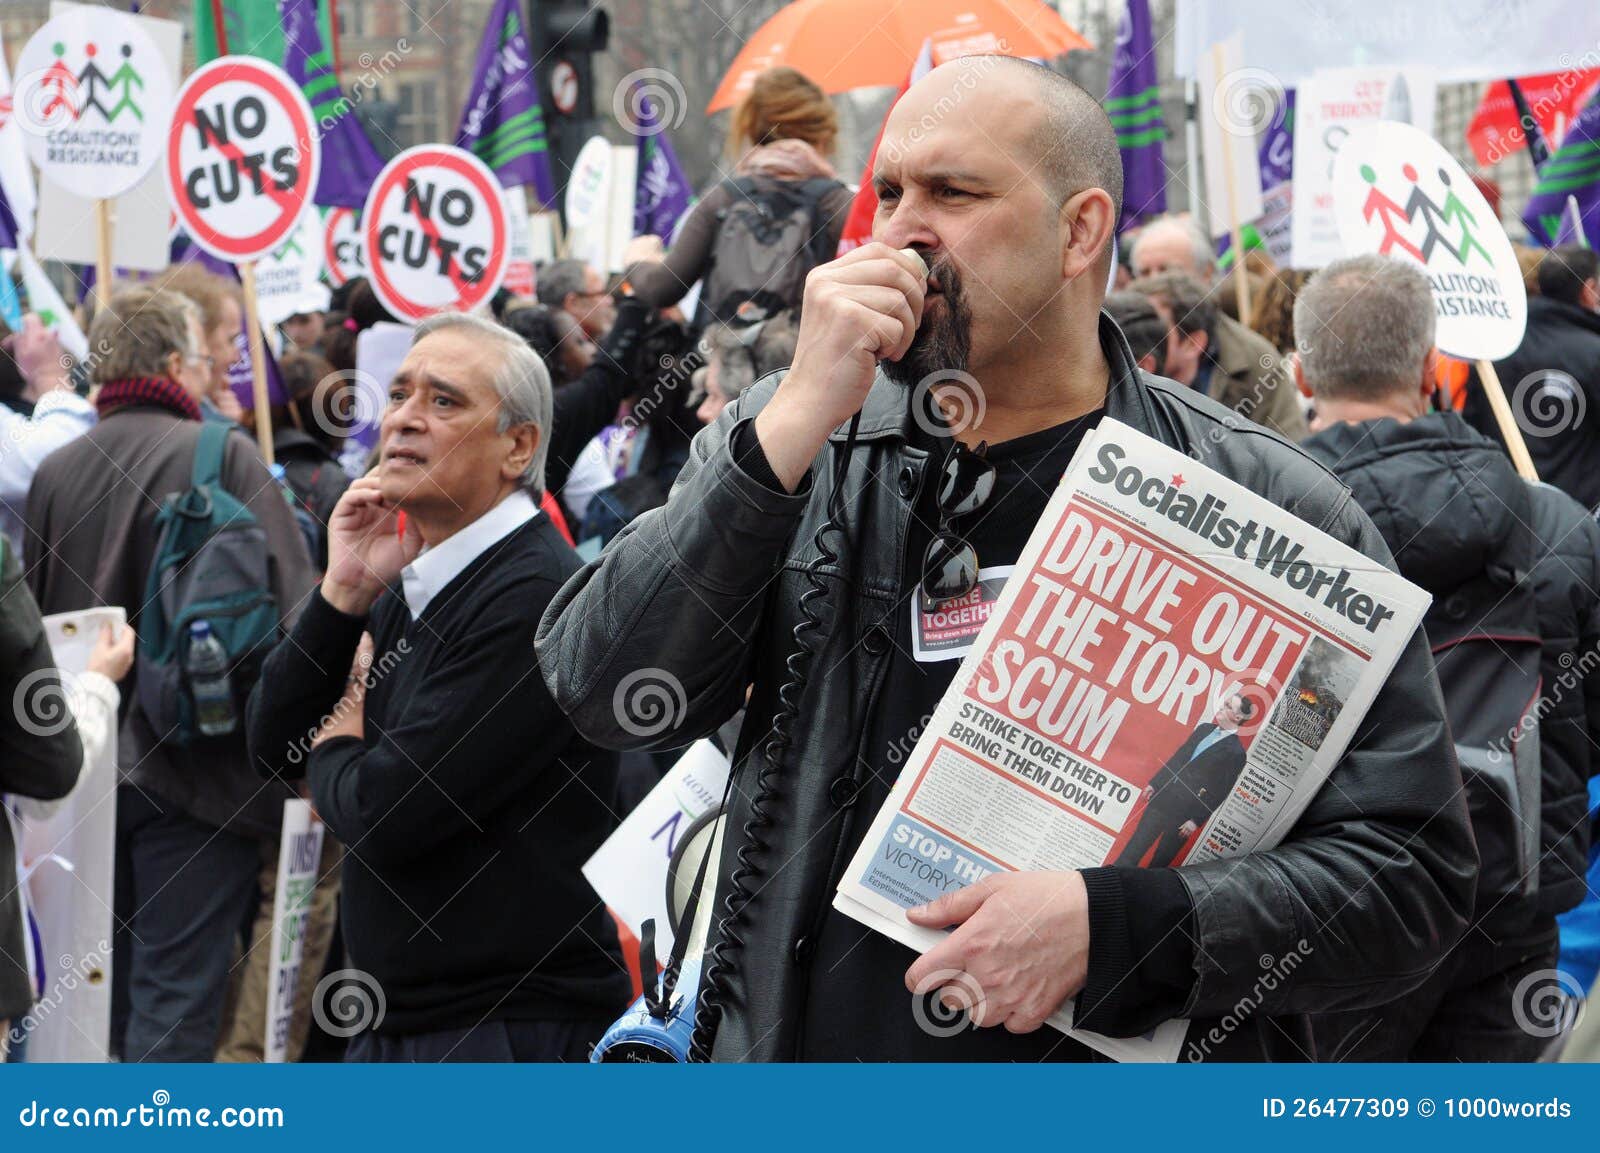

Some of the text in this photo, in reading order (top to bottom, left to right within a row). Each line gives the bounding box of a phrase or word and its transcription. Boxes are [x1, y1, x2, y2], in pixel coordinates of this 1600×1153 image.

[47, 130, 134, 145] COALITION
[194, 96, 267, 150] NO
[47, 148, 139, 166] RESISTANCE
[186, 147, 299, 209] CUTS
[403, 177, 474, 227] NO
[378, 225, 486, 283] CUTS
[1428, 272, 1497, 297] ALITION
[1041, 510, 1304, 688] DRIVE OUT
[1014, 573, 1244, 726] THE TORY
[977, 640, 1131, 762] SCUM
[948, 720, 1105, 816] BRING THEM DOWN
[959, 702, 1132, 804] STRIKE TOGETHER TO
[884, 844, 960, 892] VICTORY
[892, 823, 953, 864] STOP
[868, 875, 899, 896] Egyptian
